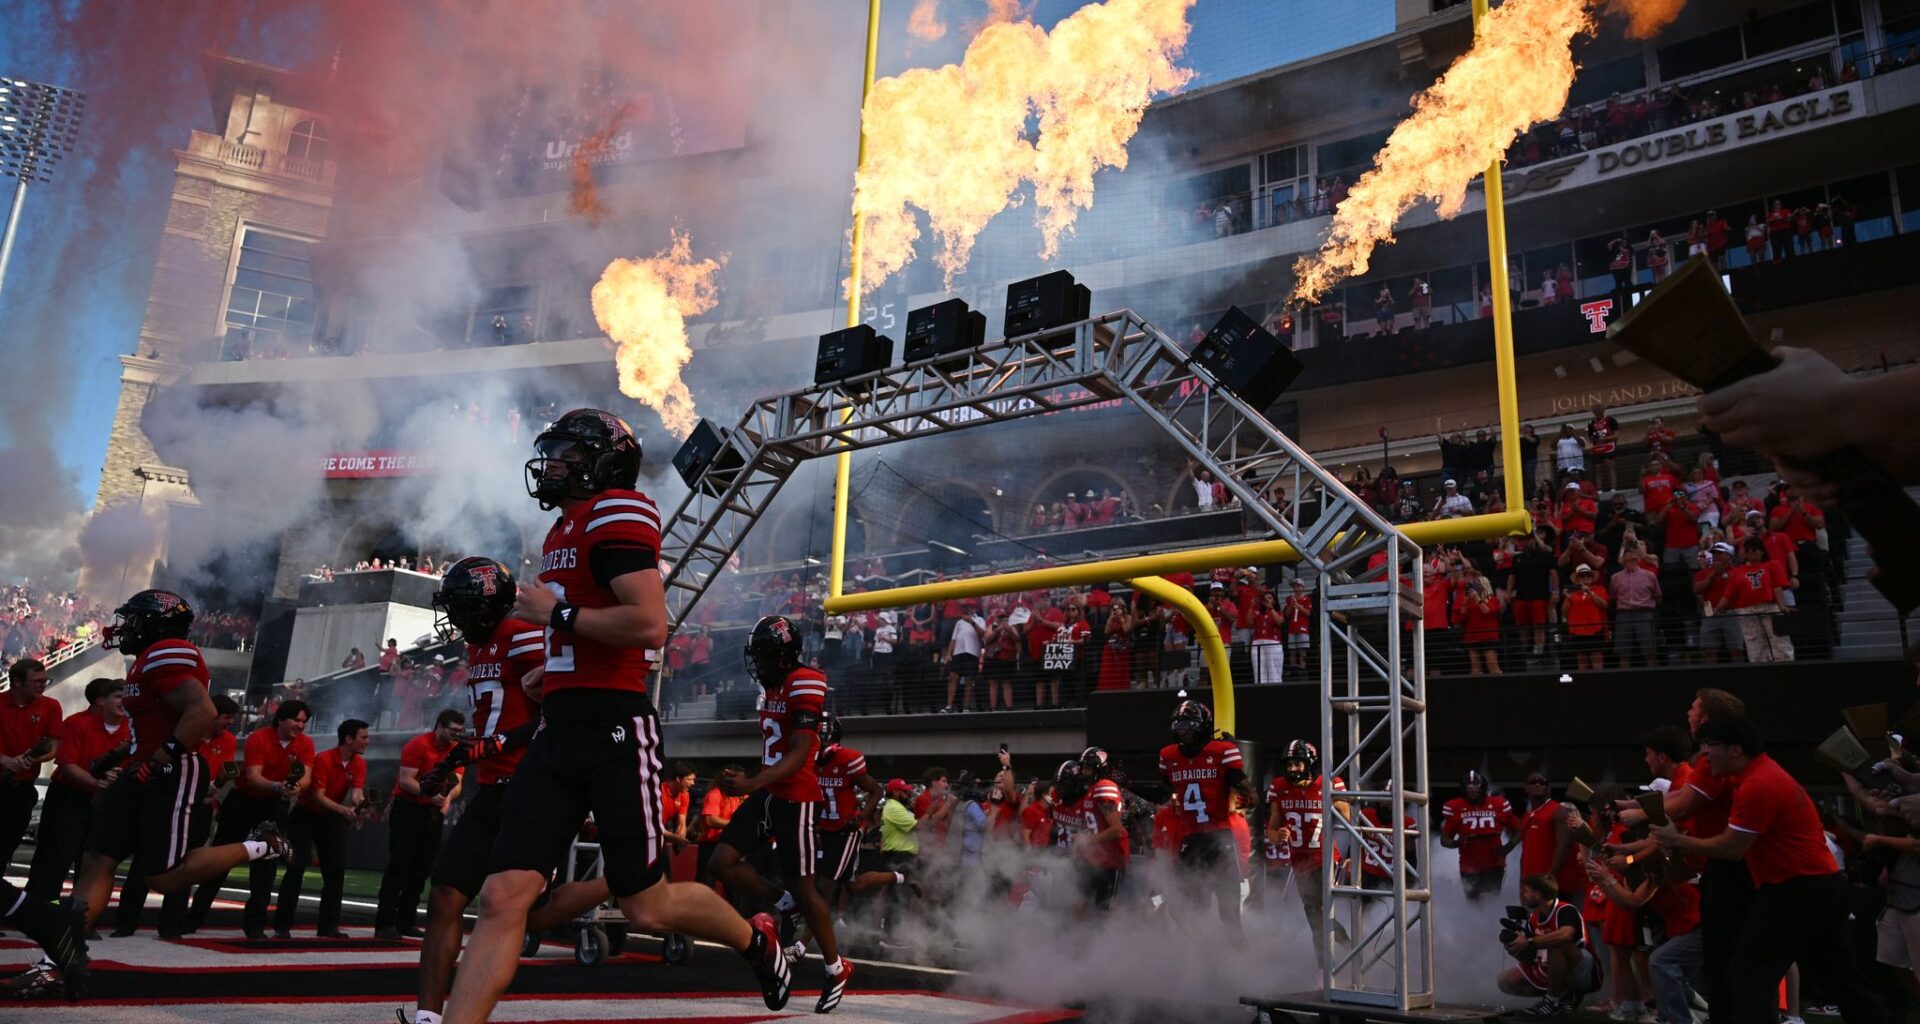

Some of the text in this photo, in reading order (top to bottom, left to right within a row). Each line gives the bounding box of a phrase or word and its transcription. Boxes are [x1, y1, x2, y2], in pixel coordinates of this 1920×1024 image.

[1598, 90, 1852, 173] DOUBLE EAGLE
[546, 131, 632, 159] Uned
[1551, 393, 1600, 414] JOHN
[1608, 384, 1652, 403] AND
[338, 457, 376, 470] COME
[378, 456, 406, 469] THE
[1046, 643, 1074, 654] IT'S
[1044, 660, 1072, 670] DAY
[469, 680, 504, 739] 7
[818, 777, 843, 787] AIDERS
[1183, 768, 1217, 780] RAIDERS
[1183, 782, 1210, 824] 4
[1281, 800, 1323, 810] RED RAIDER
[1284, 811, 1322, 848] 37
